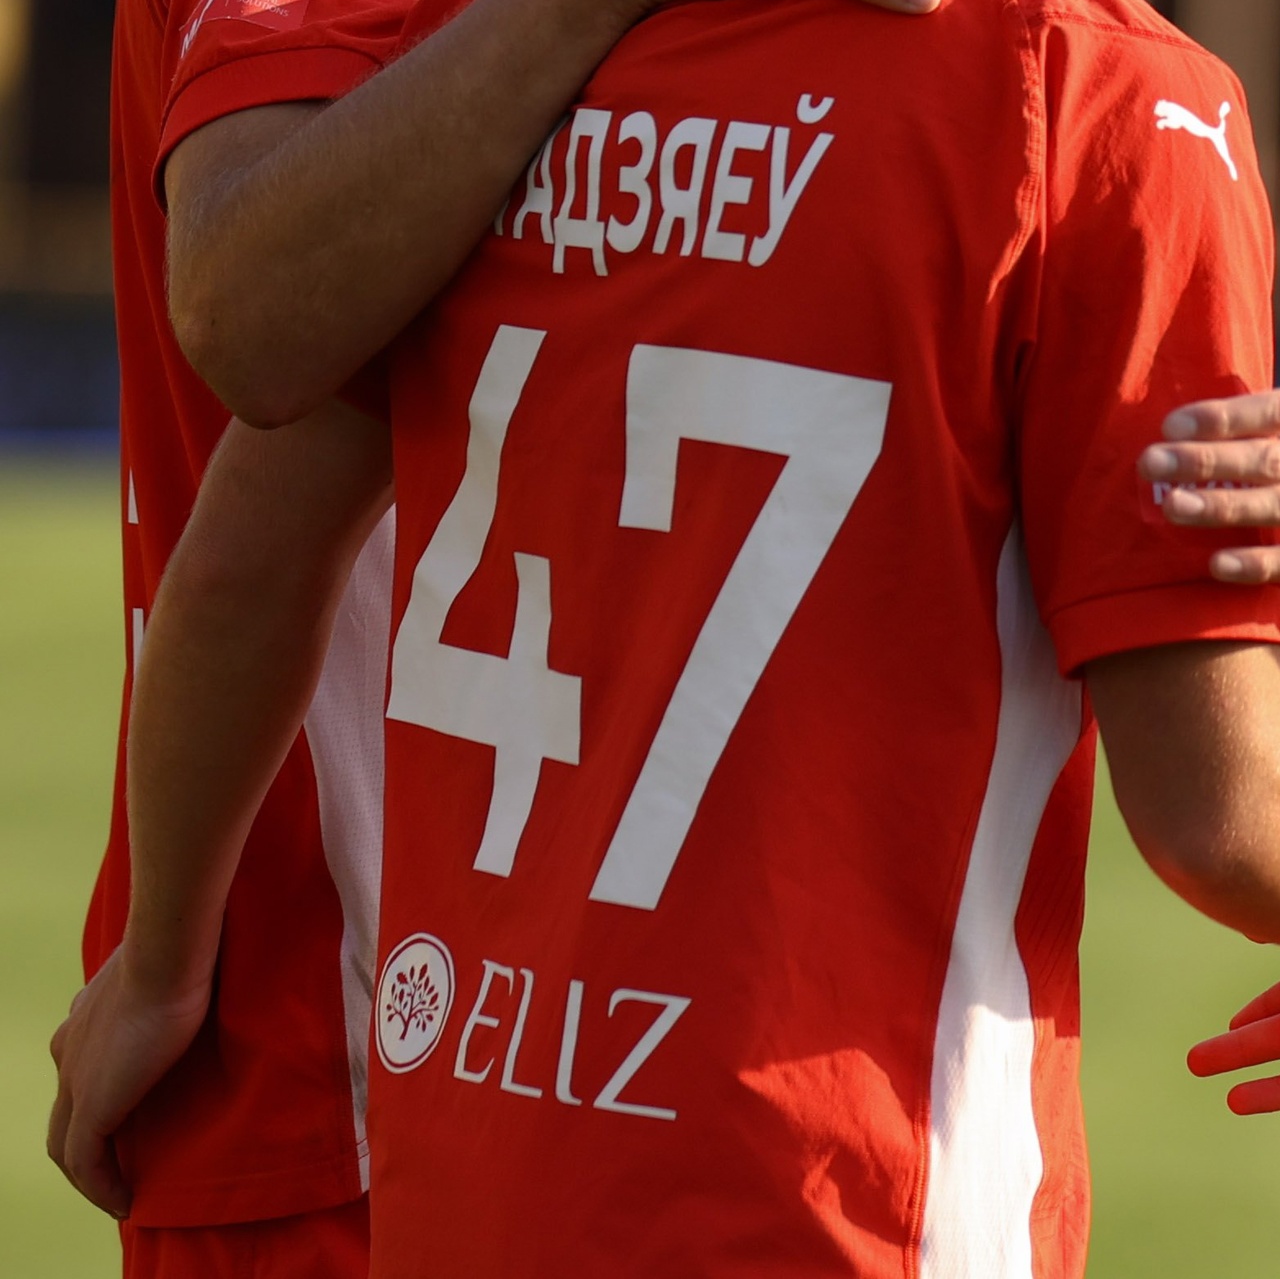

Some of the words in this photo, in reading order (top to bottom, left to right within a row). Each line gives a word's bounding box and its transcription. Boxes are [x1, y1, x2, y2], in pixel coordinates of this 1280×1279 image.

[495, 93, 835, 277] АДЗЯЕЎ
[386, 324, 892, 911] 47
[453, 958, 692, 1121] ELIZ
